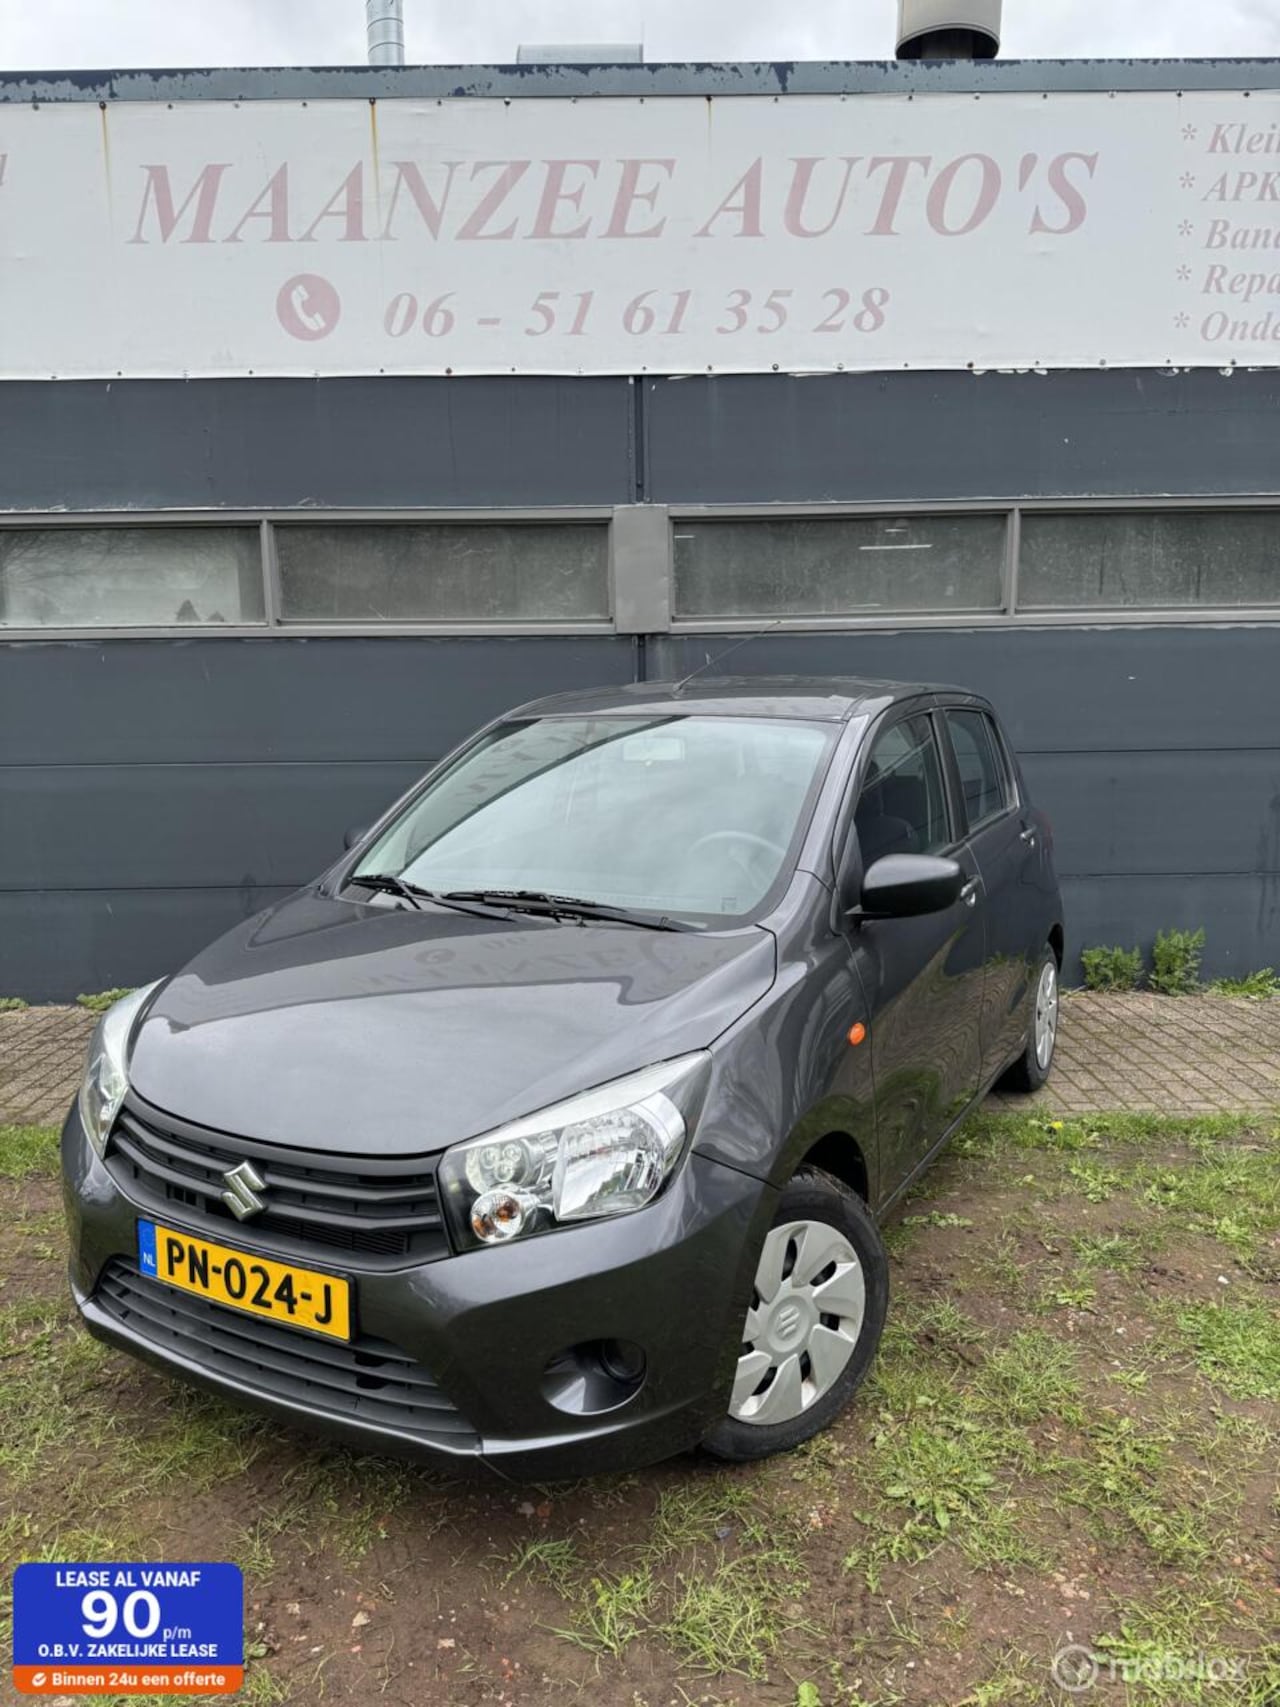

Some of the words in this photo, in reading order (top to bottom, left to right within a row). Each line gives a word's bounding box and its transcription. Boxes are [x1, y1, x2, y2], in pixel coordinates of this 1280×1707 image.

[1207, 123, 1280, 154] Klei
[125, 157, 677, 244] MAANZEE
[692, 151, 1100, 239] AUTO'S
[383, 291, 457, 338] 06
[524, 290, 595, 337] 51
[622, 289, 692, 336] 61
[716, 288, 793, 335] 35
[812, 287, 891, 334] 28
[142, 1251, 156, 1267] NL
[166, 1237, 333, 1325] PN-024-J
